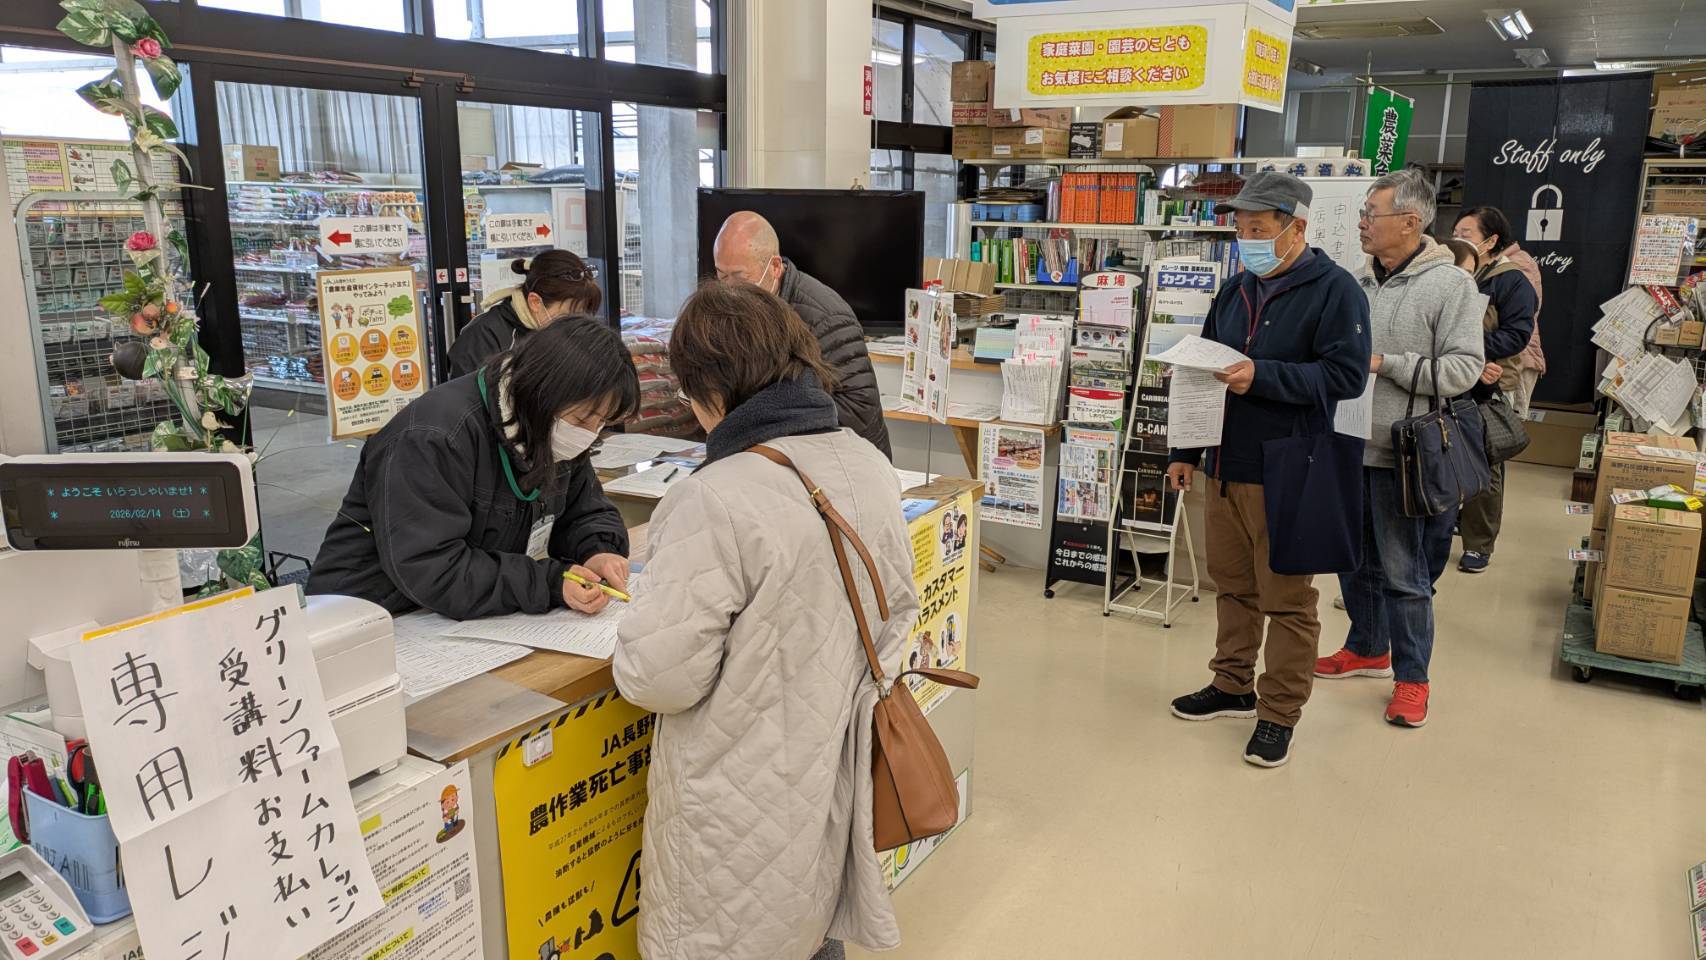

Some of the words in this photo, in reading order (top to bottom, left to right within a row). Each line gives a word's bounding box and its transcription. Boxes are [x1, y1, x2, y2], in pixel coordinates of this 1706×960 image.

[1041, 34, 1191, 58] 家庭菜園・園芸のことも
[1041, 66, 1189, 87] お気軽にご相談ください
[1493, 138, 1557, 174] Staff
[1558, 137, 1606, 174] only
[1161, 274, 1211, 286] カクイチ
[61, 487, 102, 497] ようこそ
[110, 509, 161, 519] 2026/02/14
[118, 538, 140, 548] FUJITSU
[255, 606, 359, 925] グリーンファームカレッジ
[219, 647, 311, 928] 受講料お支払い
[110, 651, 238, 960] 専用レジ
